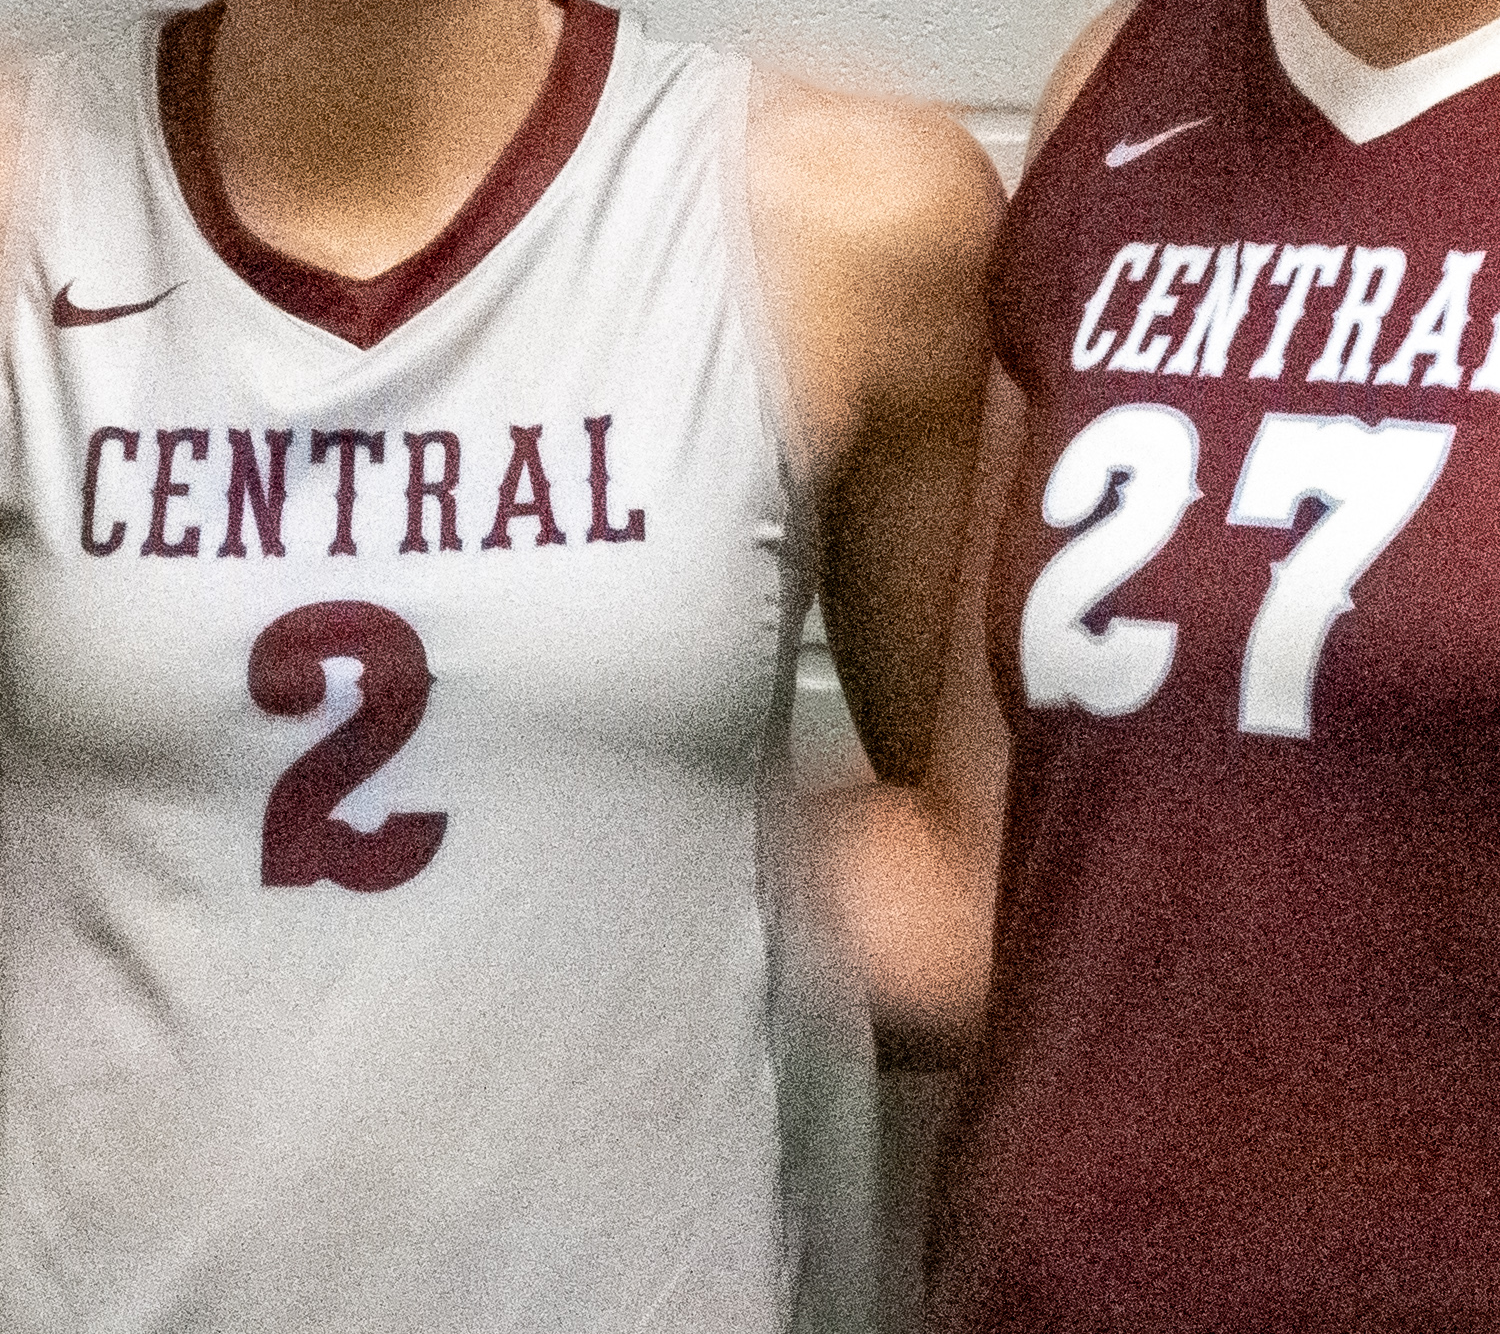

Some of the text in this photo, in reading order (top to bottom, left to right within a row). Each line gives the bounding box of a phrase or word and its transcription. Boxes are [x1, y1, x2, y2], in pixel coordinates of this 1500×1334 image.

[80, 413, 646, 557] CENTRAL
[1019, 401, 1457, 740] 27
[246, 599, 449, 893] 2
